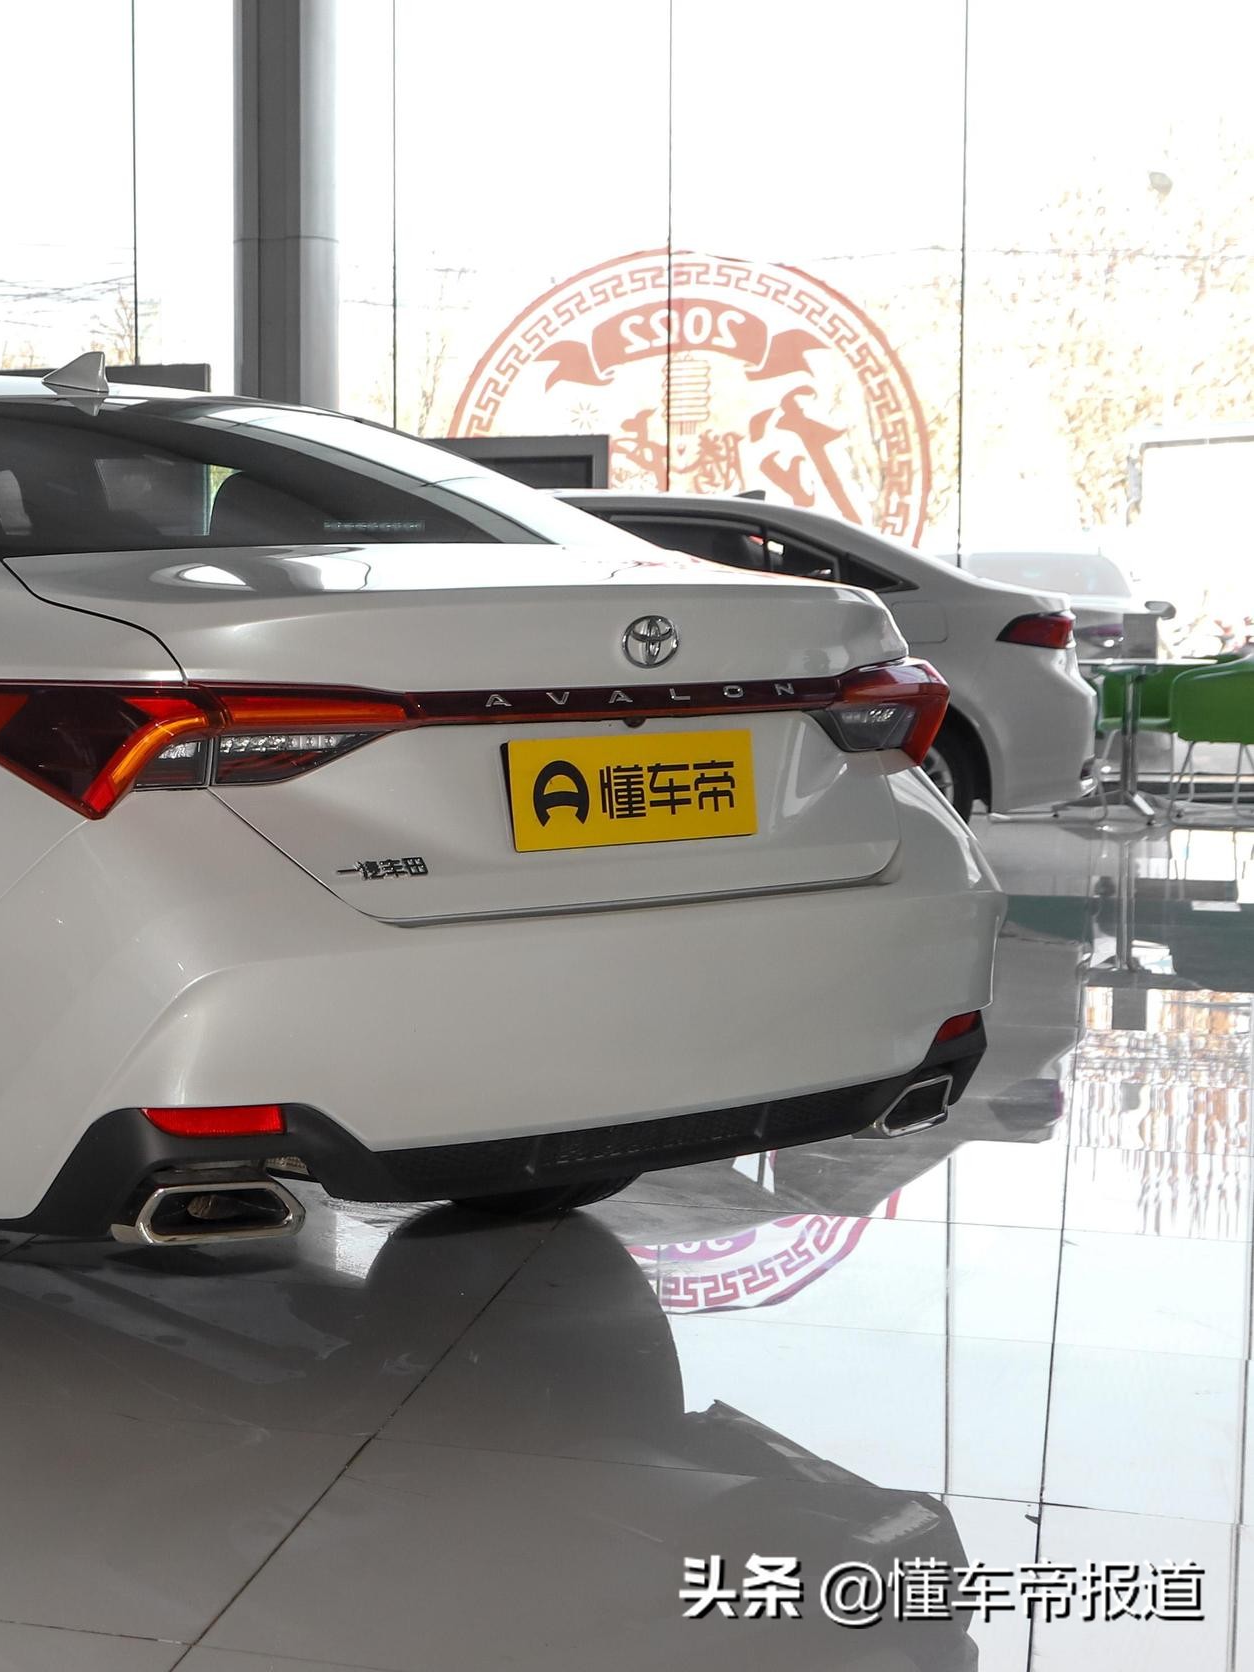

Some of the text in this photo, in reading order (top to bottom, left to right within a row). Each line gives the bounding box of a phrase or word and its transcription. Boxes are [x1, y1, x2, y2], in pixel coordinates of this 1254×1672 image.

[485, 683, 795, 708] AVALON
[599, 759, 735, 820] 懂车帝
